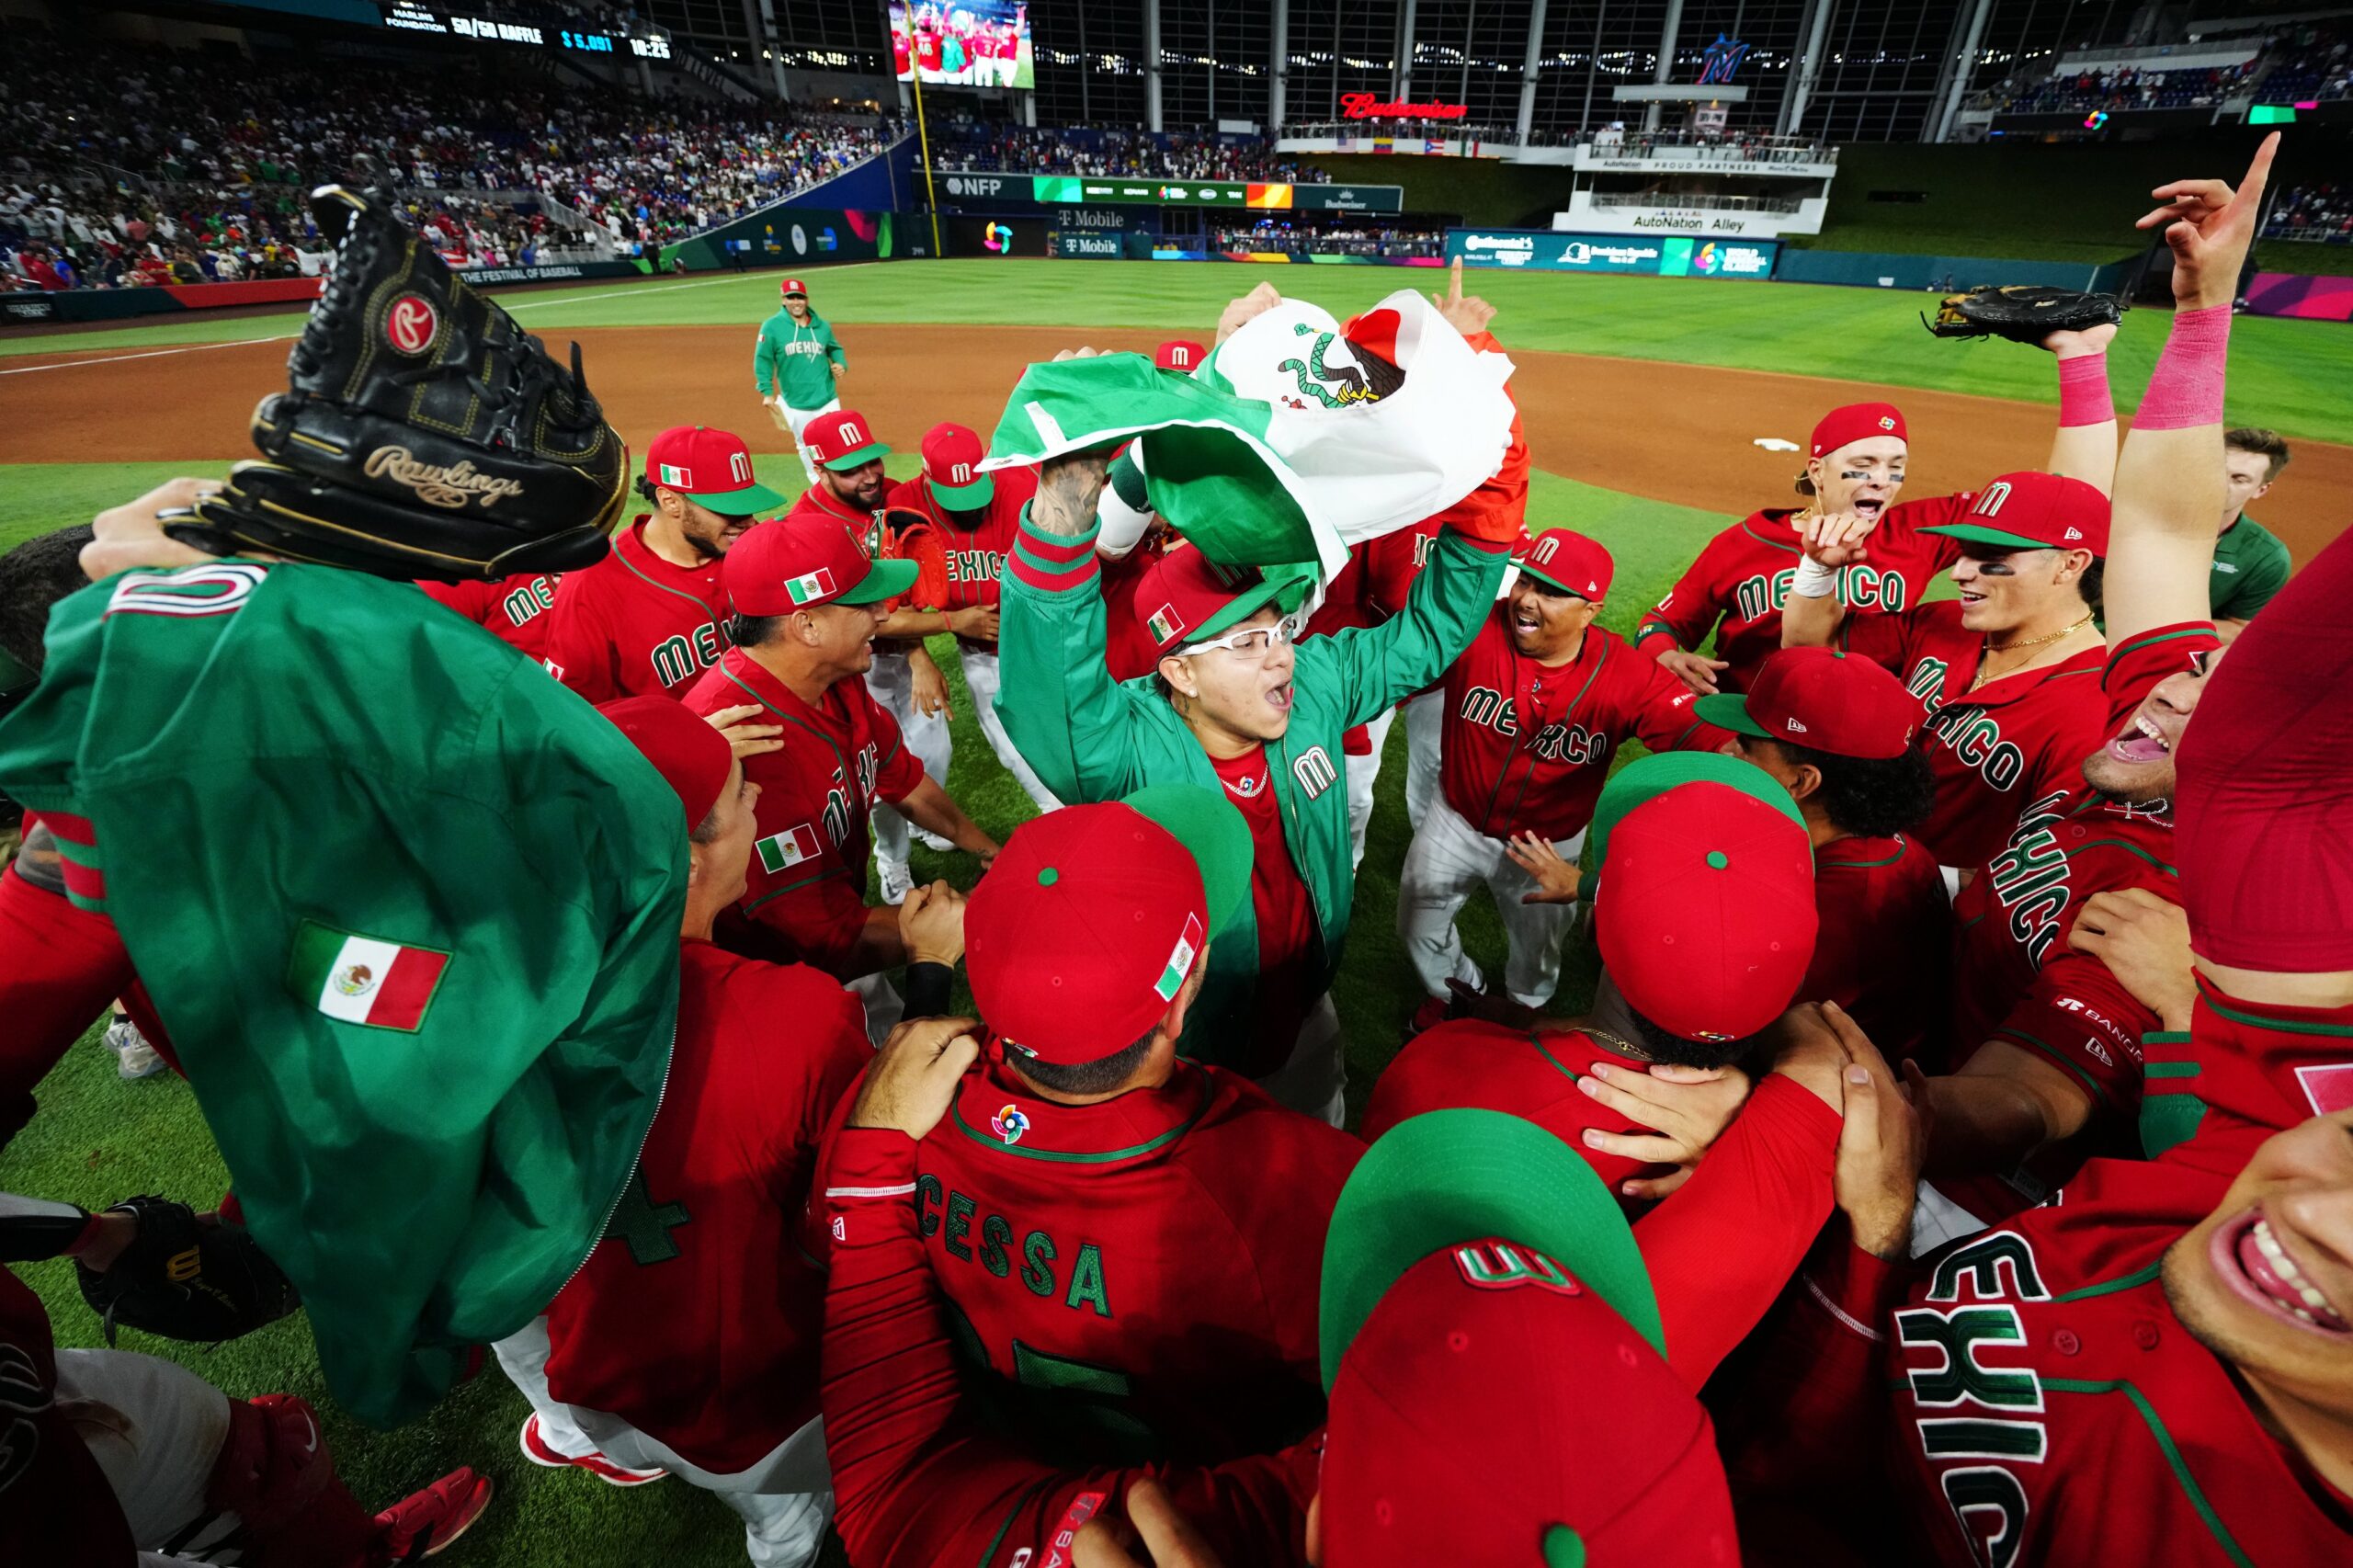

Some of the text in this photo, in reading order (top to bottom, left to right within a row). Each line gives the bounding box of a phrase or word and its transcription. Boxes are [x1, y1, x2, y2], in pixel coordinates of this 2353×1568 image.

[392, 9, 435, 22] MARLINS
[385, 17, 448, 33] FOUNDATION
[450, 17, 544, 44] 50/50 RAFFLE
[1340, 92, 1469, 119] Budweiser
[1699, 164, 1757, 172] PARTNERS
[965, 178, 1002, 196] NFP
[1324, 199, 1367, 210] Budweiser
[1074, 210, 1125, 228] Mobile
[1633, 215, 1745, 231] AutoNation Alley
[1080, 237, 1118, 254] Mobile
[461, 266, 582, 283] THE FESTIVAL OF BASEBALL
[364, 445, 524, 506] Rawlings
[1737, 564, 1905, 623] MEICO
[917, 1173, 1113, 1320] CESSA
